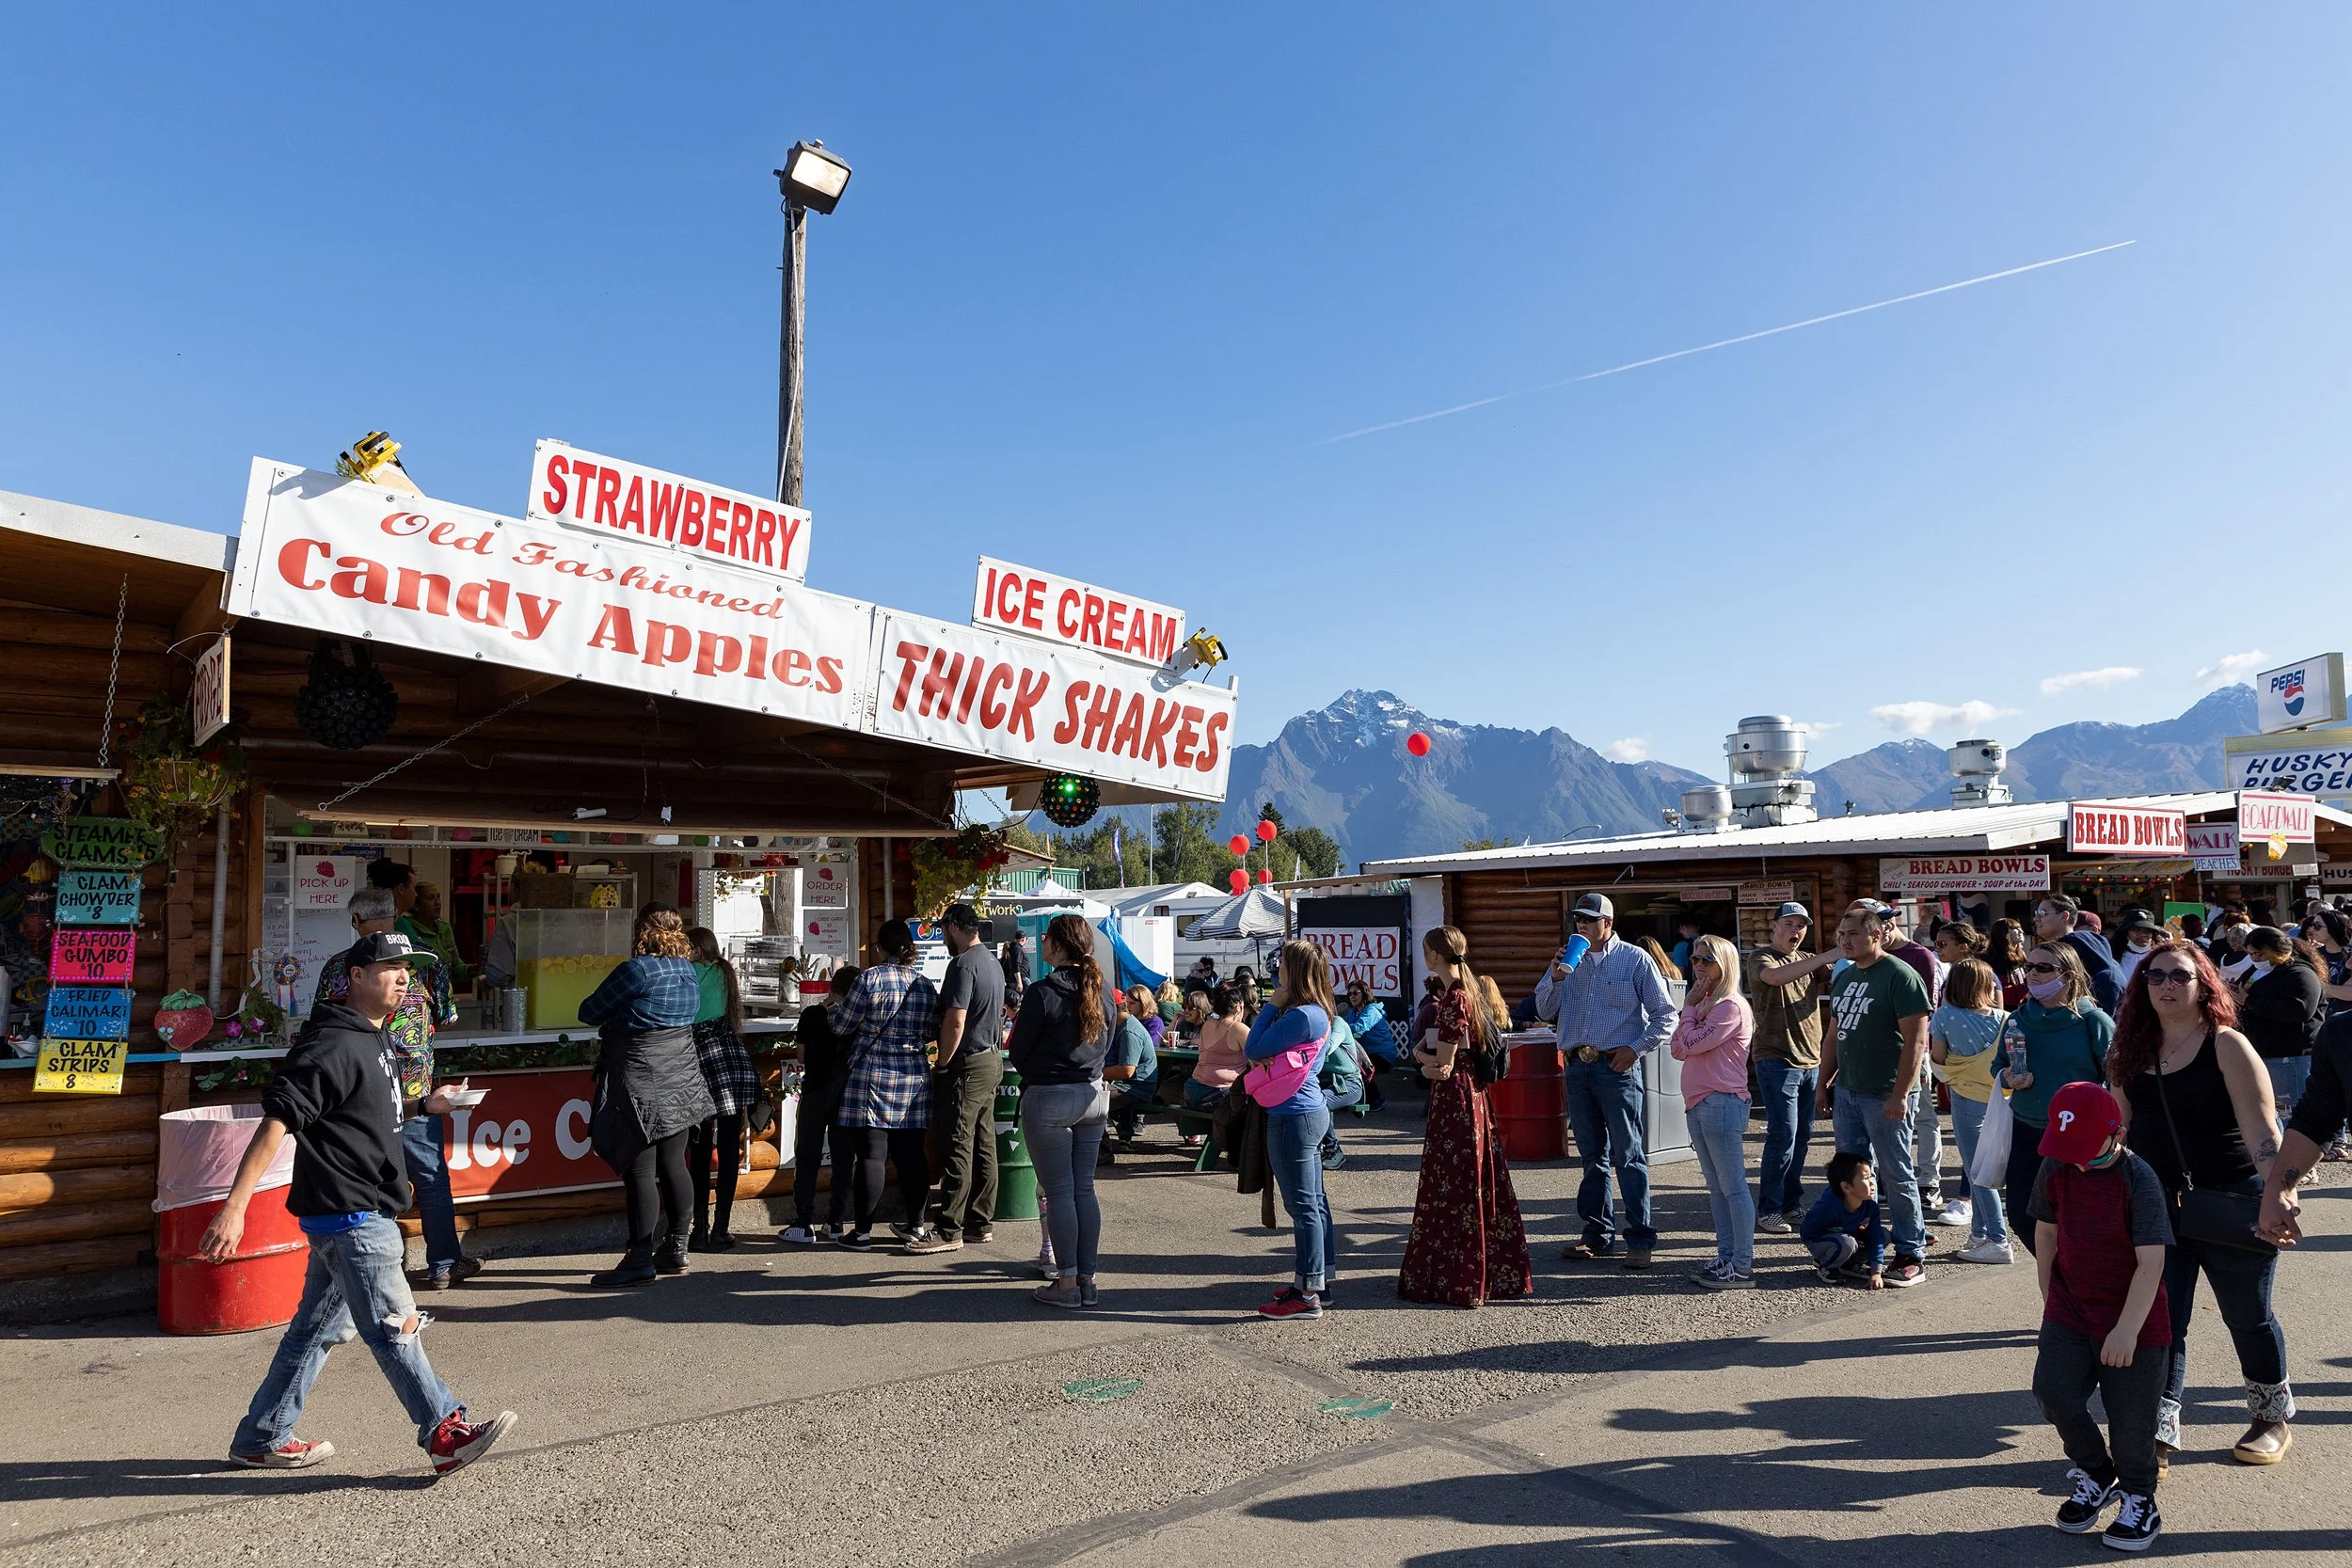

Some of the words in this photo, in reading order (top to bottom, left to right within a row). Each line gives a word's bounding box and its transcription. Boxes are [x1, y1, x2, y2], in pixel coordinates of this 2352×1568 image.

[544, 454, 801, 571] STRAWBERRY
[381, 511, 495, 555] Old
[511, 541, 785, 620] Fashioned
[278, 538, 563, 641] Candy
[586, 604, 845, 695] Apples
[983, 568, 1047, 631] ICE
[1057, 588, 1178, 665] CREAM
[2270, 669, 2306, 693] PEPSI
[891, 641, 1051, 743] THICK
[1053, 680, 1229, 772] SHAKES
[2246, 752, 2352, 774] HUSKY
[2242, 803, 2312, 832] BOARDWALK
[2074, 812, 2130, 845] BREAD
[2134, 815, 2184, 847] BOWLS
[2187, 832, 2238, 849] WALK
[55, 841, 129, 864] CLAMS
[1909, 860, 1973, 875] BREAD
[1978, 858, 2045, 874] BOWLS
[2195, 858, 2238, 870] PEACHES
[2262, 864, 2295, 877] BURGE
[77, 876, 130, 891] CLAM
[300, 878, 329, 888] PICK
[334, 878, 349, 888] UP
[806, 880, 843, 892] ORDER
[1907, 880, 1940, 889] SEAFOOD
[1940, 880, 1977, 889] CHOWDER
[1982, 879, 2004, 888] SOUP
[2005, 879, 2013, 889] of
[2013, 879, 2027, 888] the
[2028, 879, 2046, 888] DAY
[59, 893, 135, 907] CHOWDER
[310, 894, 339, 904] HERE
[810, 895, 836, 905] HERE
[86, 906, 103, 920] $8
[57, 932, 133, 947] SEAFOOD
[385, 934, 411, 944] BROO
[65, 948, 129, 964] GUMBO
[81, 963, 105, 979] $10
[1328, 963, 1399, 991] OWLS
[69, 990, 112, 1003] FRIED
[1843, 981, 1869, 997] GO
[51, 1005, 128, 1018] CALIMARI
[1832, 996, 1875, 1015] PACK
[1836, 1031, 1847, 1041] G
[59, 1041, 118, 1059] CLAM
[47, 1058, 110, 1073] STRIPS
[787, 1064, 804, 1075] Ap
[2058, 1110, 2075, 1132] P
[447, 1108, 532, 1171] Ice
[554, 1098, 601, 1162] C
